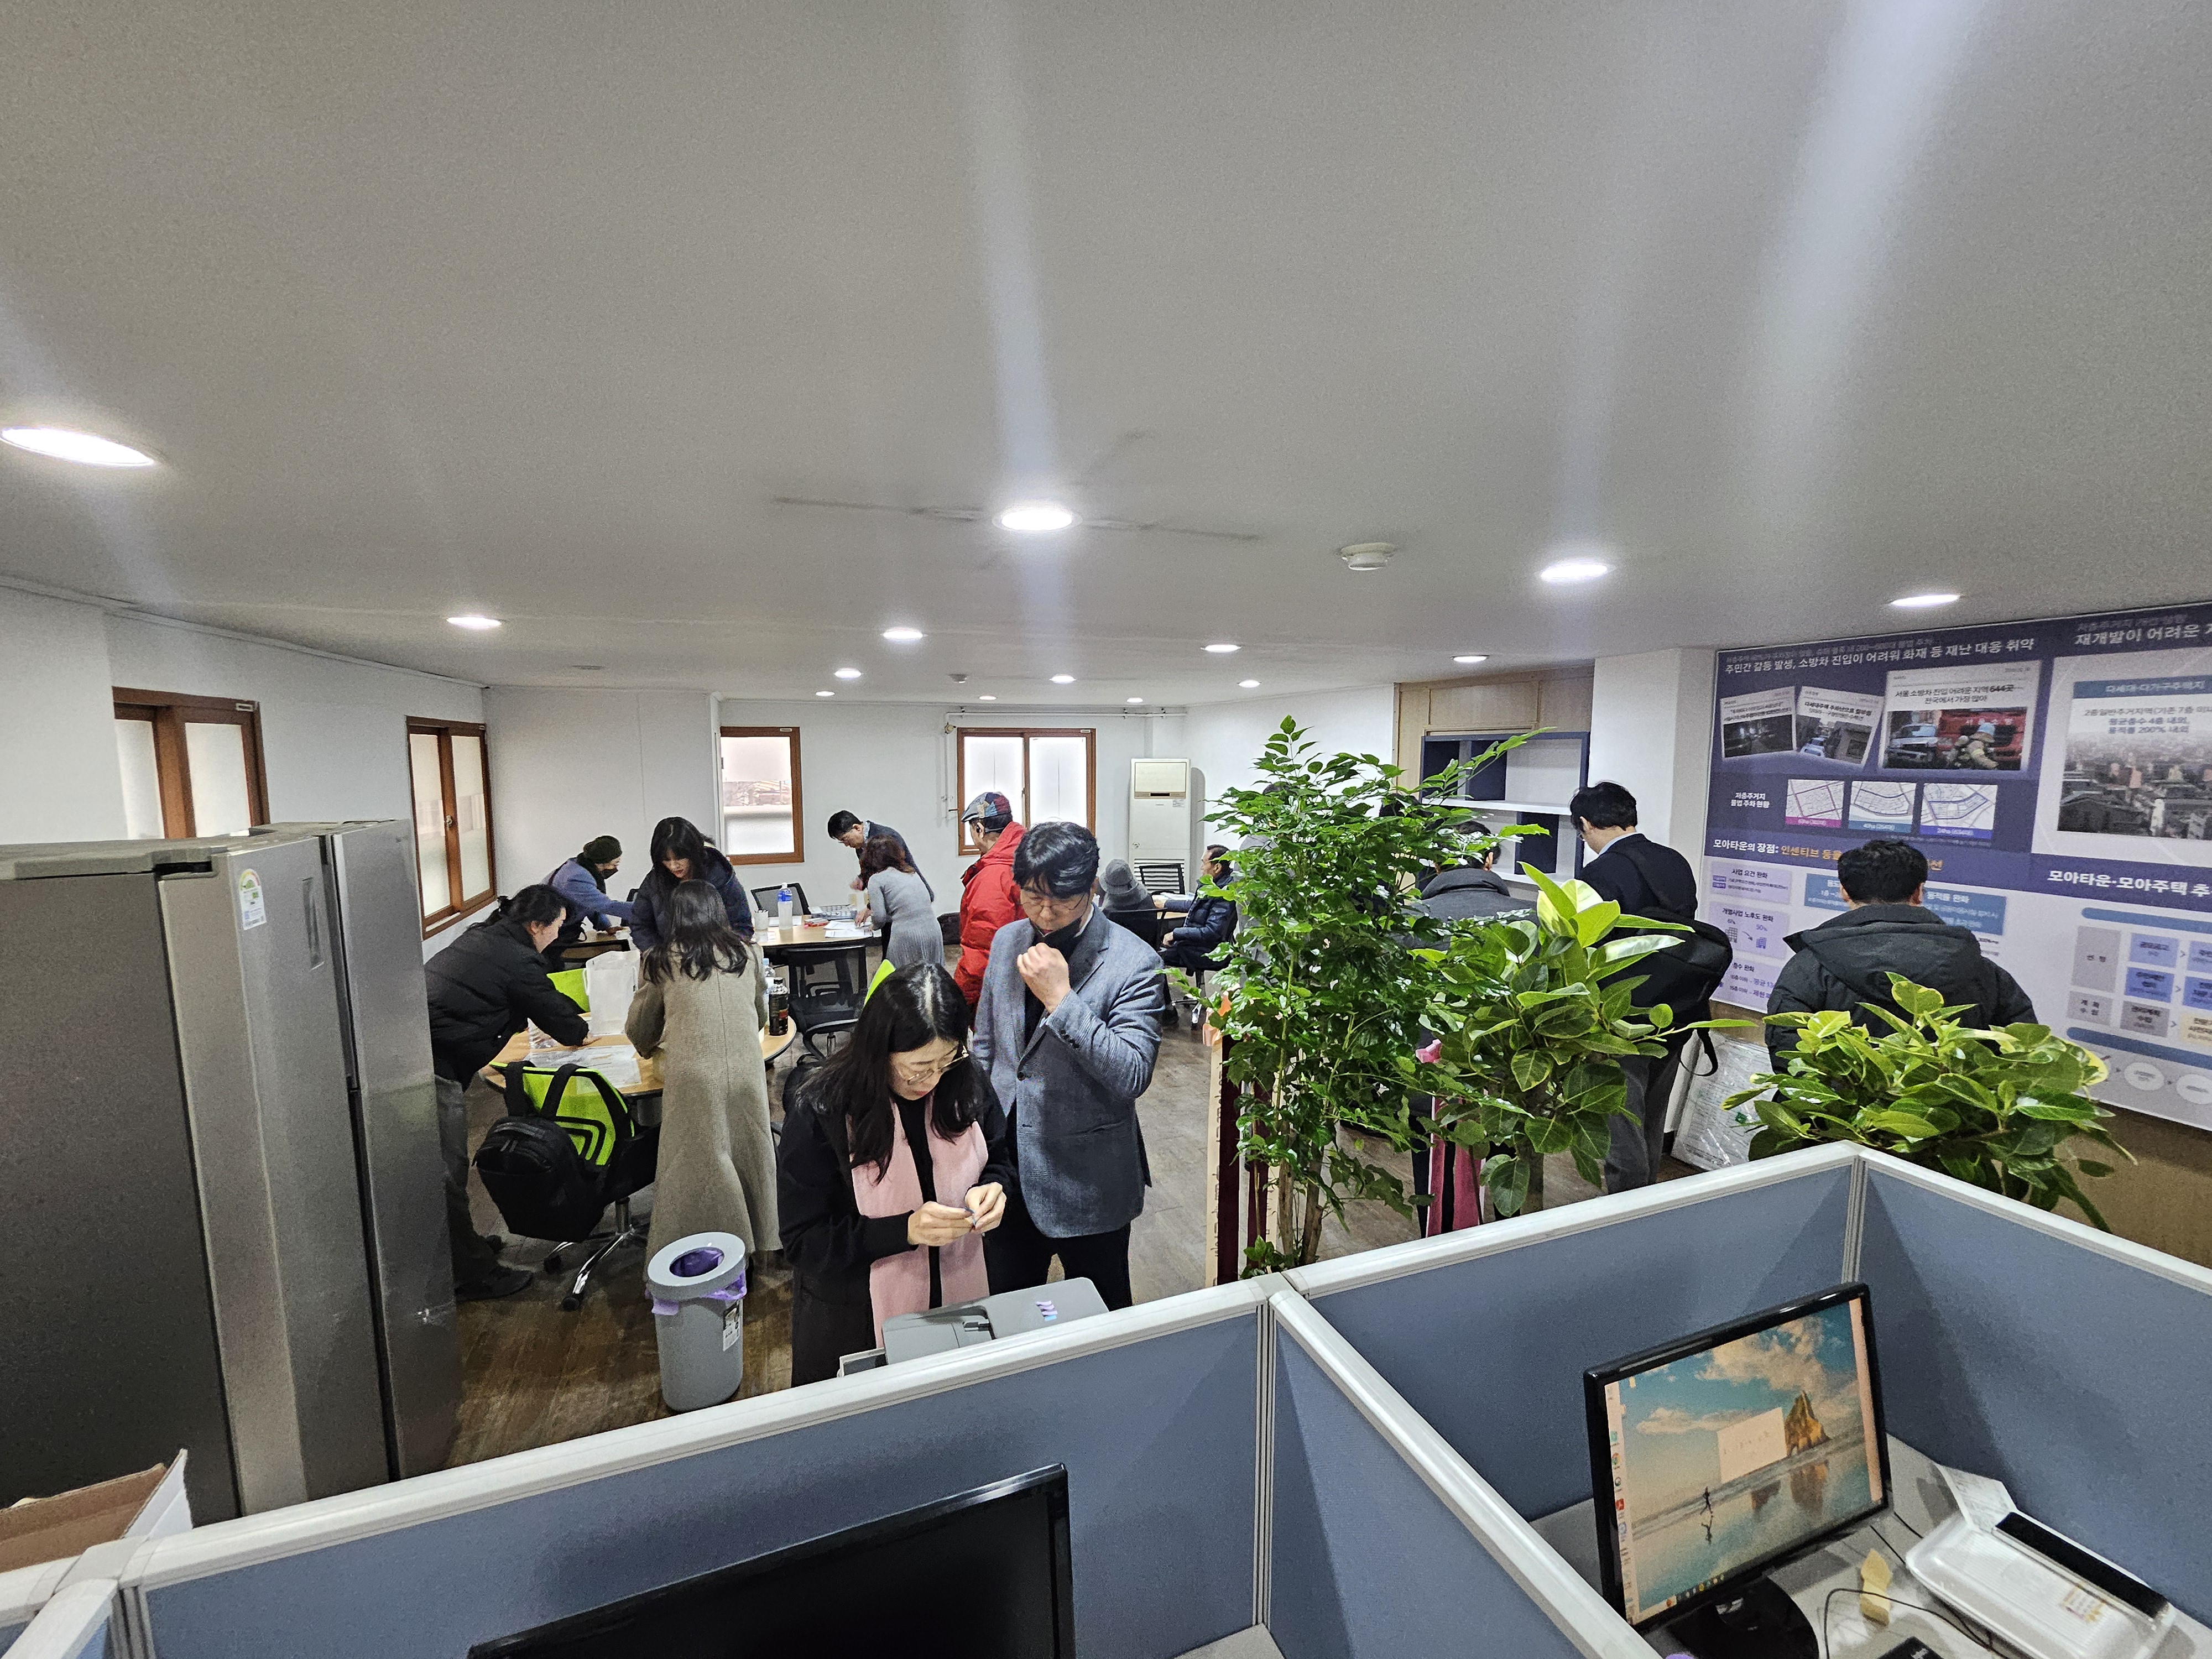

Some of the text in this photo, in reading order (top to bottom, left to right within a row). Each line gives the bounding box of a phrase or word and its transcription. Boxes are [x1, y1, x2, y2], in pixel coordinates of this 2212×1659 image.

[2075, 628, 2142, 645] 재개발이
[2147, 624, 2200, 640] 어려운
[1725, 664, 1752, 674] 주민간
[1754, 662, 1772, 672] 갈등
[1774, 660, 1796, 670] 발생,
[1798, 656, 1829, 668] 소방차
[1832, 653, 1864, 666] 진입이
[1866, 649, 1901, 662] 어려워
[1902, 647, 1927, 660] 화재
[1929, 645, 1943, 658] 등
[1945, 644, 1972, 656] 재난
[1975, 641, 2002, 654] 대응
[2006, 638, 2035, 651] 취약
[1713, 839, 1755, 852] 모아타운의
[1757, 842, 1780, 854] 장점:
[1780, 845, 1819, 858] 인센티브
[1731, 868, 1743, 876] 사업
[2047, 870, 2212, 897] 모아타운·모아주택 추
[1744, 912, 1761, 920] 노후도
